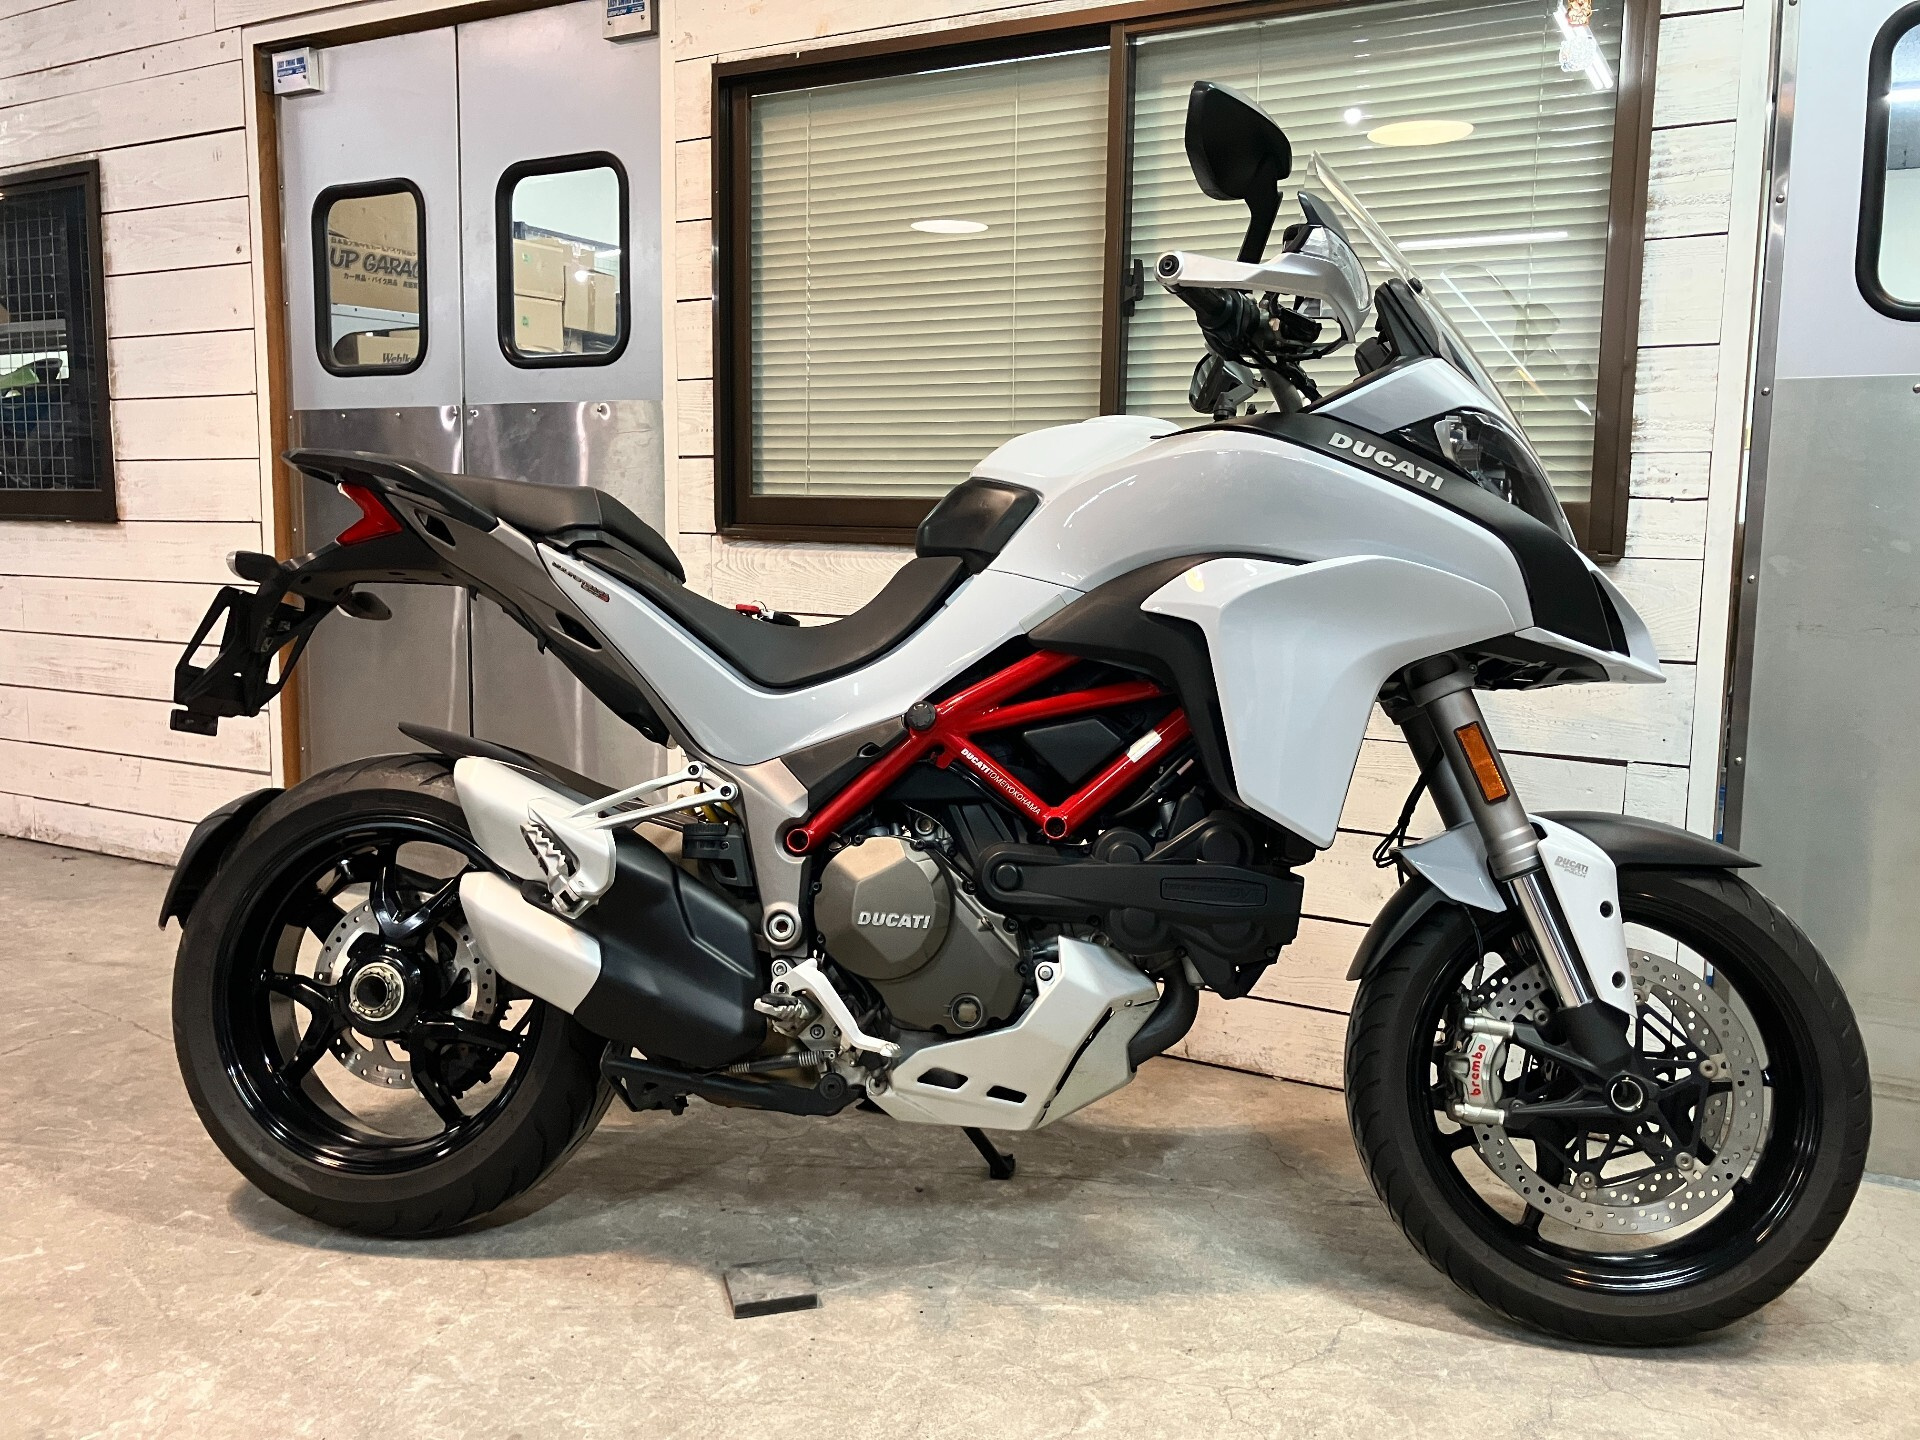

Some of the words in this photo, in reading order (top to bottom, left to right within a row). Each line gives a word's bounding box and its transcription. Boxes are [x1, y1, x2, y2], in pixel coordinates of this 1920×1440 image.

[330, 247, 360, 268] UP
[1328, 432, 1445, 491] DUCATI
[1555, 855, 1589, 873] DUCATI
[857, 911, 931, 929] DUCATI
[1470, 1044, 1487, 1096] brembo
